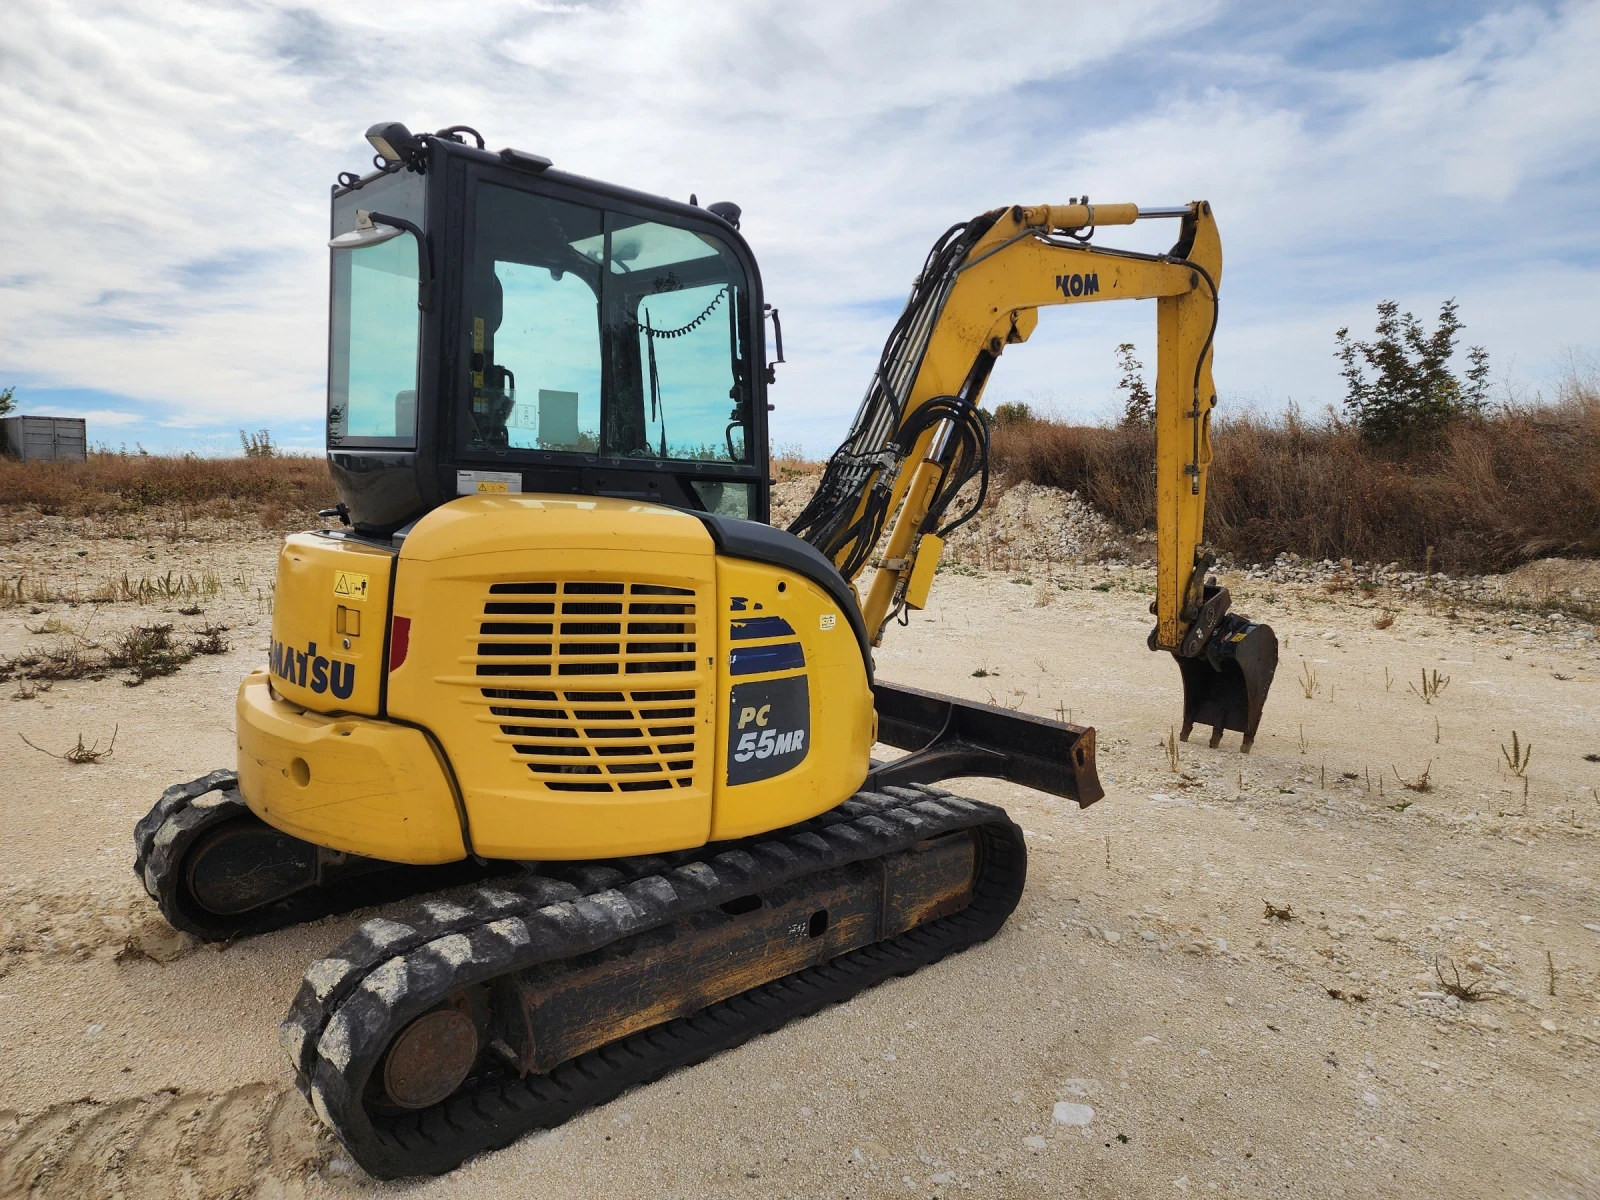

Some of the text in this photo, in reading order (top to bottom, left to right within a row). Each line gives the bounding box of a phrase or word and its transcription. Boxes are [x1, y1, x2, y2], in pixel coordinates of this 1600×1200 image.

[269, 640, 355, 699] MATSU
[737, 704, 771, 729] PC
[734, 728, 805, 763] 55MR
